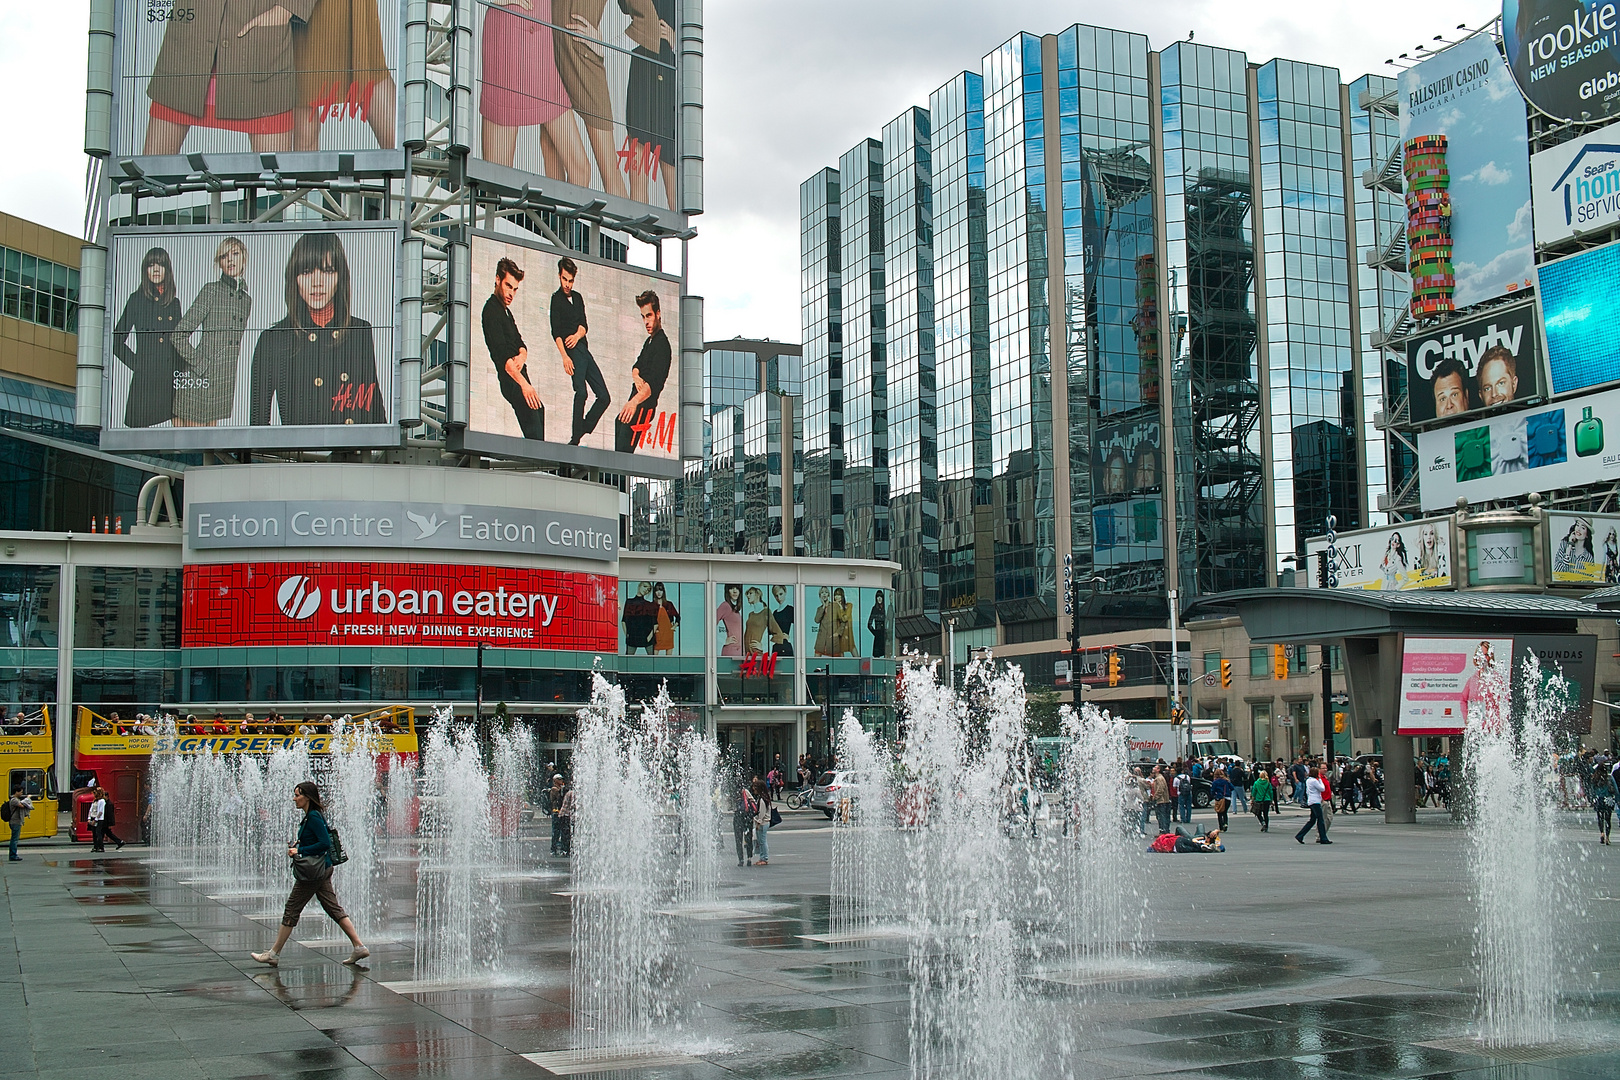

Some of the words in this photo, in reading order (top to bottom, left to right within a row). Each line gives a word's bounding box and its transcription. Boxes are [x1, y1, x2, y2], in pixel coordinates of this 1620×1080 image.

[147, 0, 174, 8] Blazer
[147, 8, 195, 23] $34.95
[1528, 2, 1617, 67] rookie
[1530, 60, 1556, 83] NEW
[1560, 35, 1609, 68] SEASON
[1409, 74, 1454, 108] FALLSVIEW
[1455, 58, 1489, 87] CASINO
[1409, 93, 1456, 118] NIAGARA
[1459, 77, 1489, 97] FALLS
[309, 80, 375, 123] H&M
[616, 135, 662, 182] H&M
[1584, 160, 1615, 178] Sears
[173, 370, 190, 378] Coat
[173, 378, 210, 390] $29.95
[331, 382, 376, 412] H&M
[630, 407, 677, 453] H&M
[1429, 462, 1451, 472] LACOSTE
[1602, 455, 1616, 463] EAU
[197, 512, 279, 539] Eaton
[290, 511, 394, 538] Centre
[458, 514, 536, 543] Eaton
[545, 521, 613, 552] Centre
[1482, 546, 1518, 561] XXI
[330, 580, 444, 615] urban
[451, 584, 559, 627] eatery
[330, 625, 339, 636] A
[344, 625, 384, 636] FRESH
[389, 625, 418, 636] NEW
[422, 626, 463, 637] DINING
[468, 627, 534, 639] EXPERIENCE
[739, 651, 778, 680] H&M
[1540, 650, 1584, 660] DUNDAS
